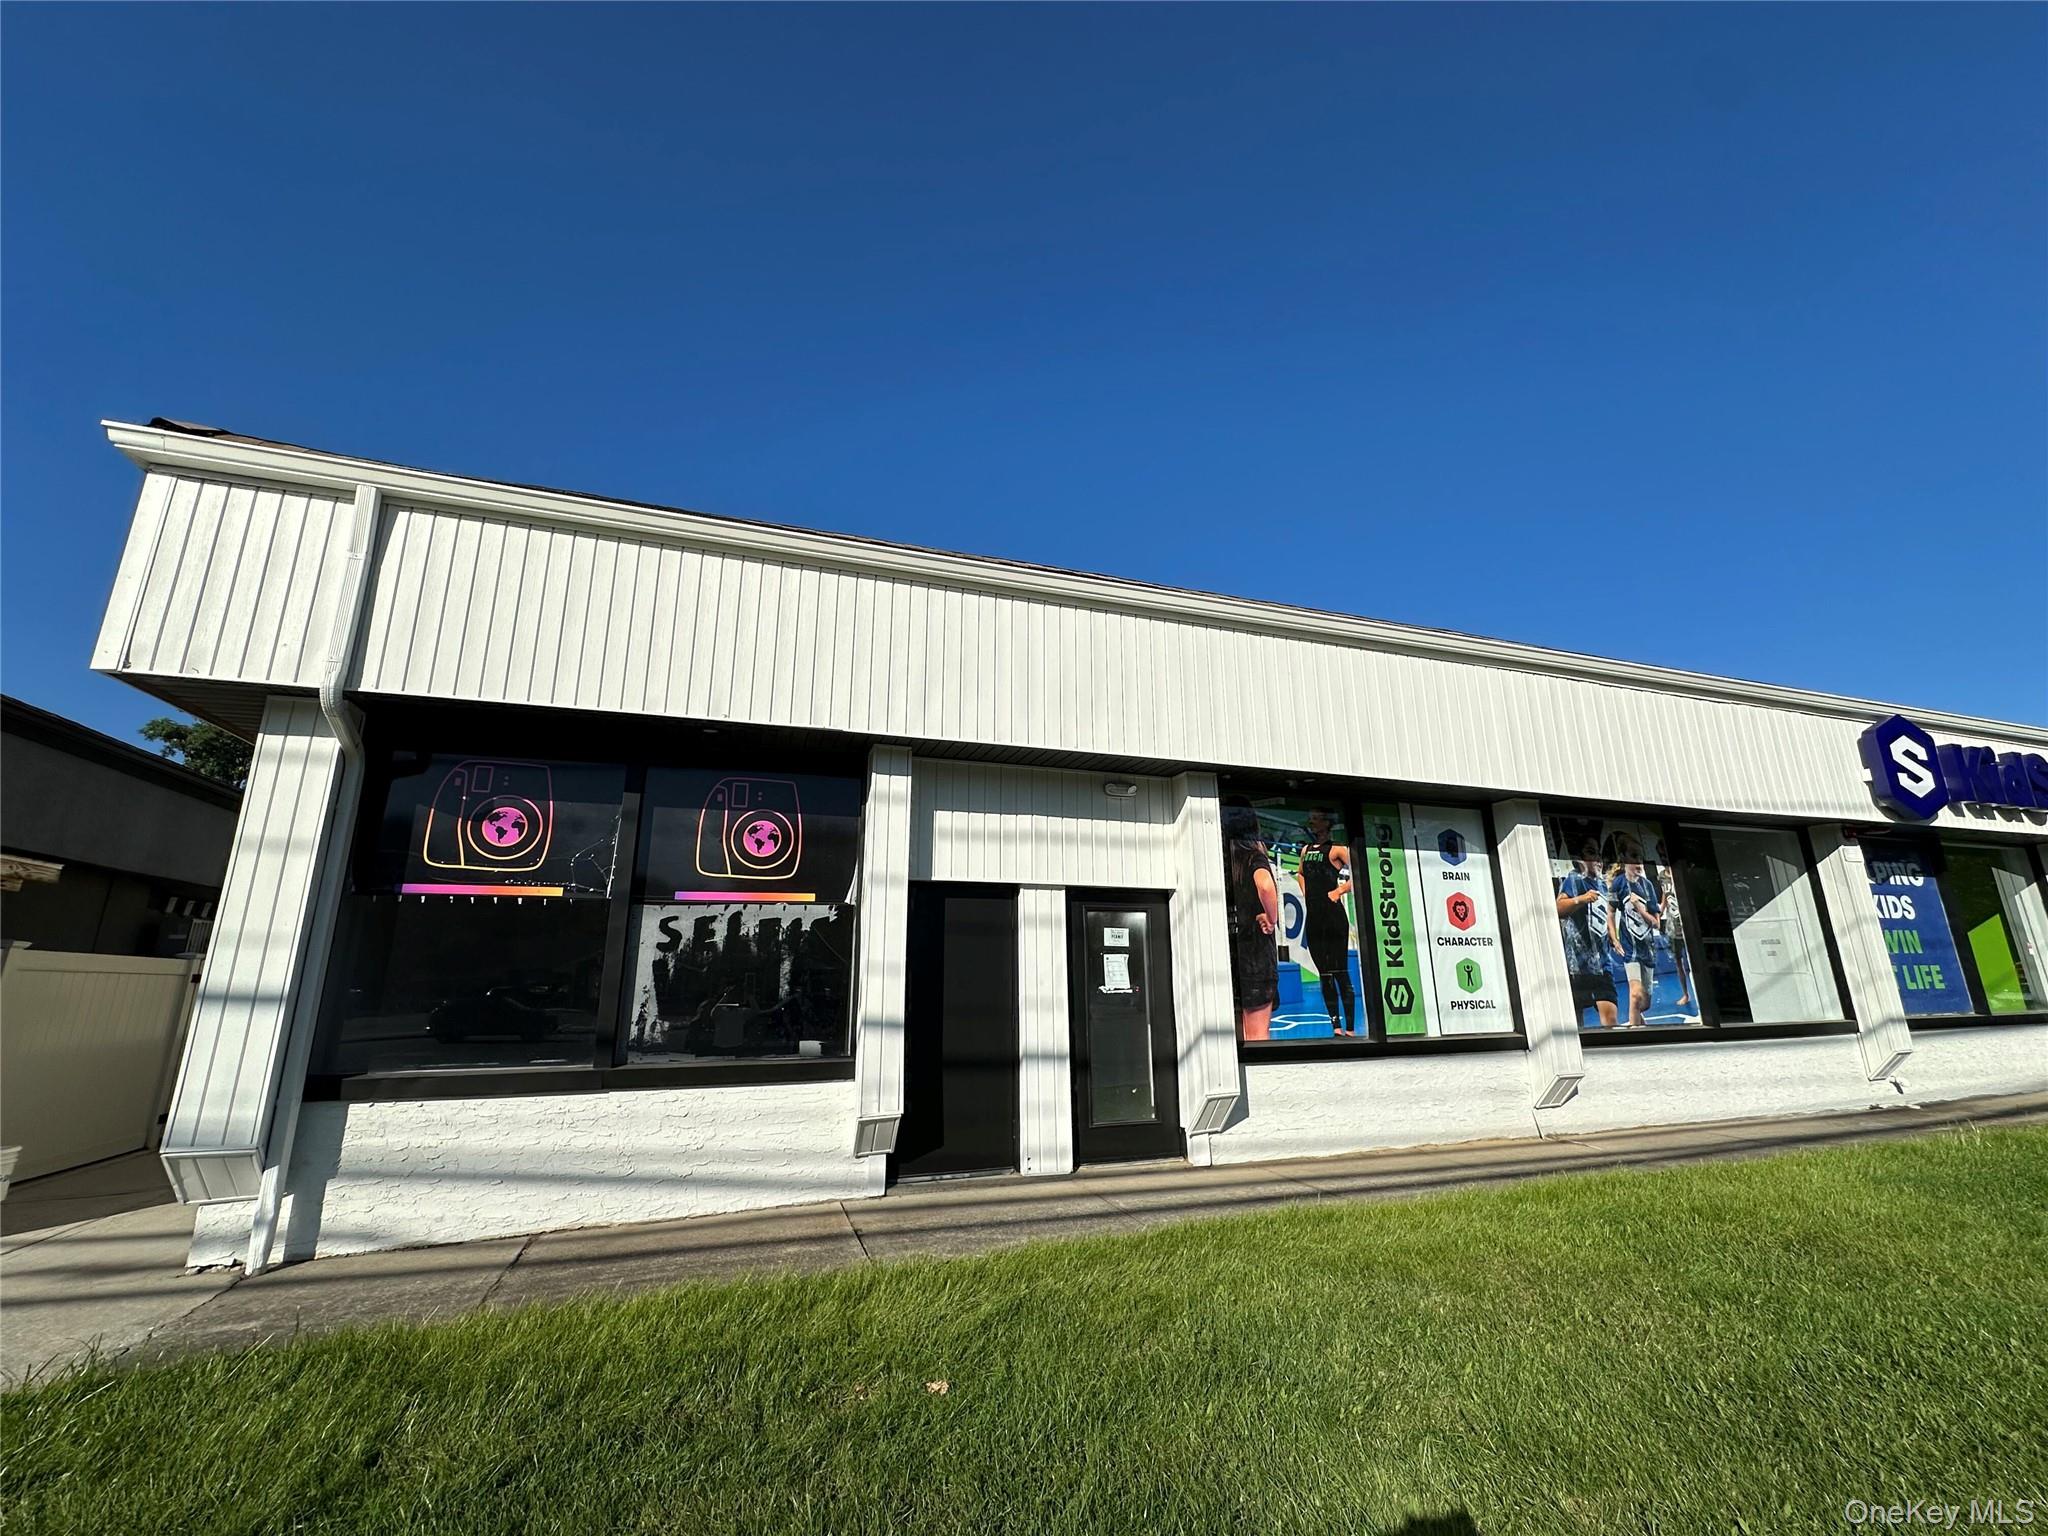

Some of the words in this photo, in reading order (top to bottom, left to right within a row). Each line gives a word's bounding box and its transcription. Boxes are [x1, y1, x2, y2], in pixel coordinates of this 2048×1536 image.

[1442, 871, 1471, 882] BRAIN
[1377, 823, 1405, 968] KidStrong
[1437, 936, 1494, 948] CHARACTER
[1903, 965, 1945, 990] LIFE
[1450, 999, 1497, 1011] PHYSICAL
